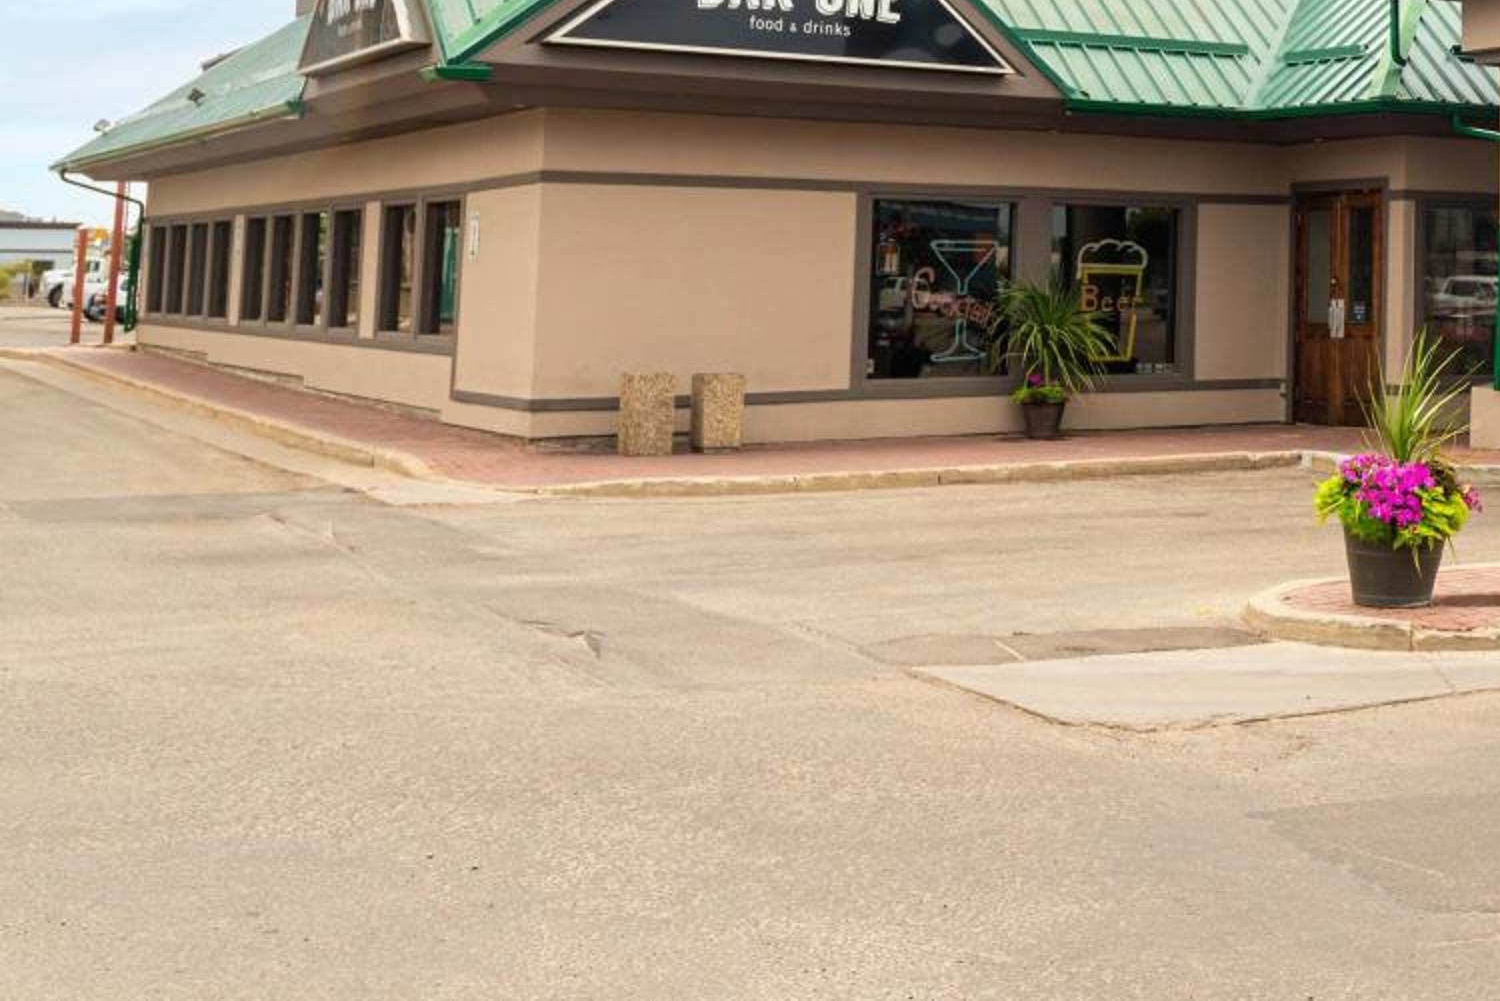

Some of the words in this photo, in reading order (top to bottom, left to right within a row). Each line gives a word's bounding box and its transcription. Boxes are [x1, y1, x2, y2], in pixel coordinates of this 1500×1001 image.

[750, 15, 784, 32] food
[789, 22, 798, 33] &
[803, 21, 852, 37] drinks
[1080, 284, 1143, 312] Beer
